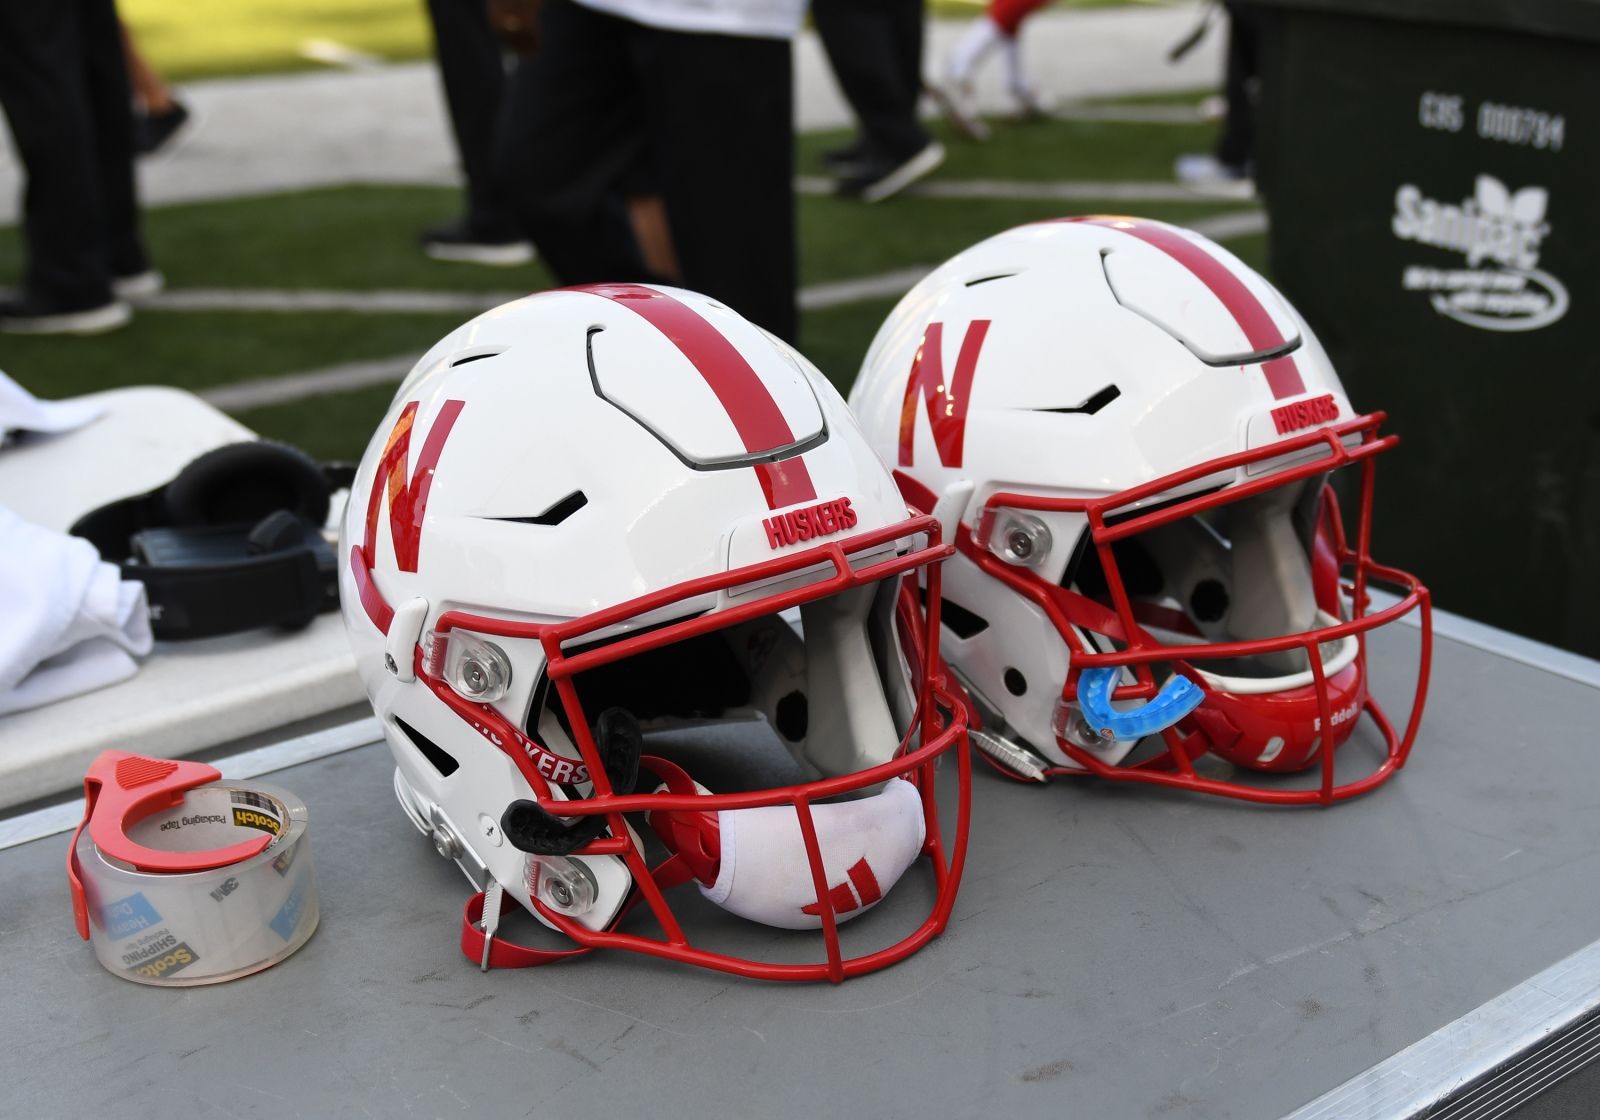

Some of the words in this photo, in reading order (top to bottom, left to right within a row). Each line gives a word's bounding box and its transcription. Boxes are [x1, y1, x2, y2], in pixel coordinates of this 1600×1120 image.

[898, 319, 992, 468] N
[1270, 393, 1340, 435] HUSKERS
[363, 399, 466, 573] N
[762, 497, 857, 549] HUSKERS
[1313, 702, 1358, 732] Rddell
[160, 820, 181, 832] Tape
[182, 815, 226, 828] Packaging
[235, 810, 281, 834] Scotch
[121, 934, 177, 965] SHIPPING
